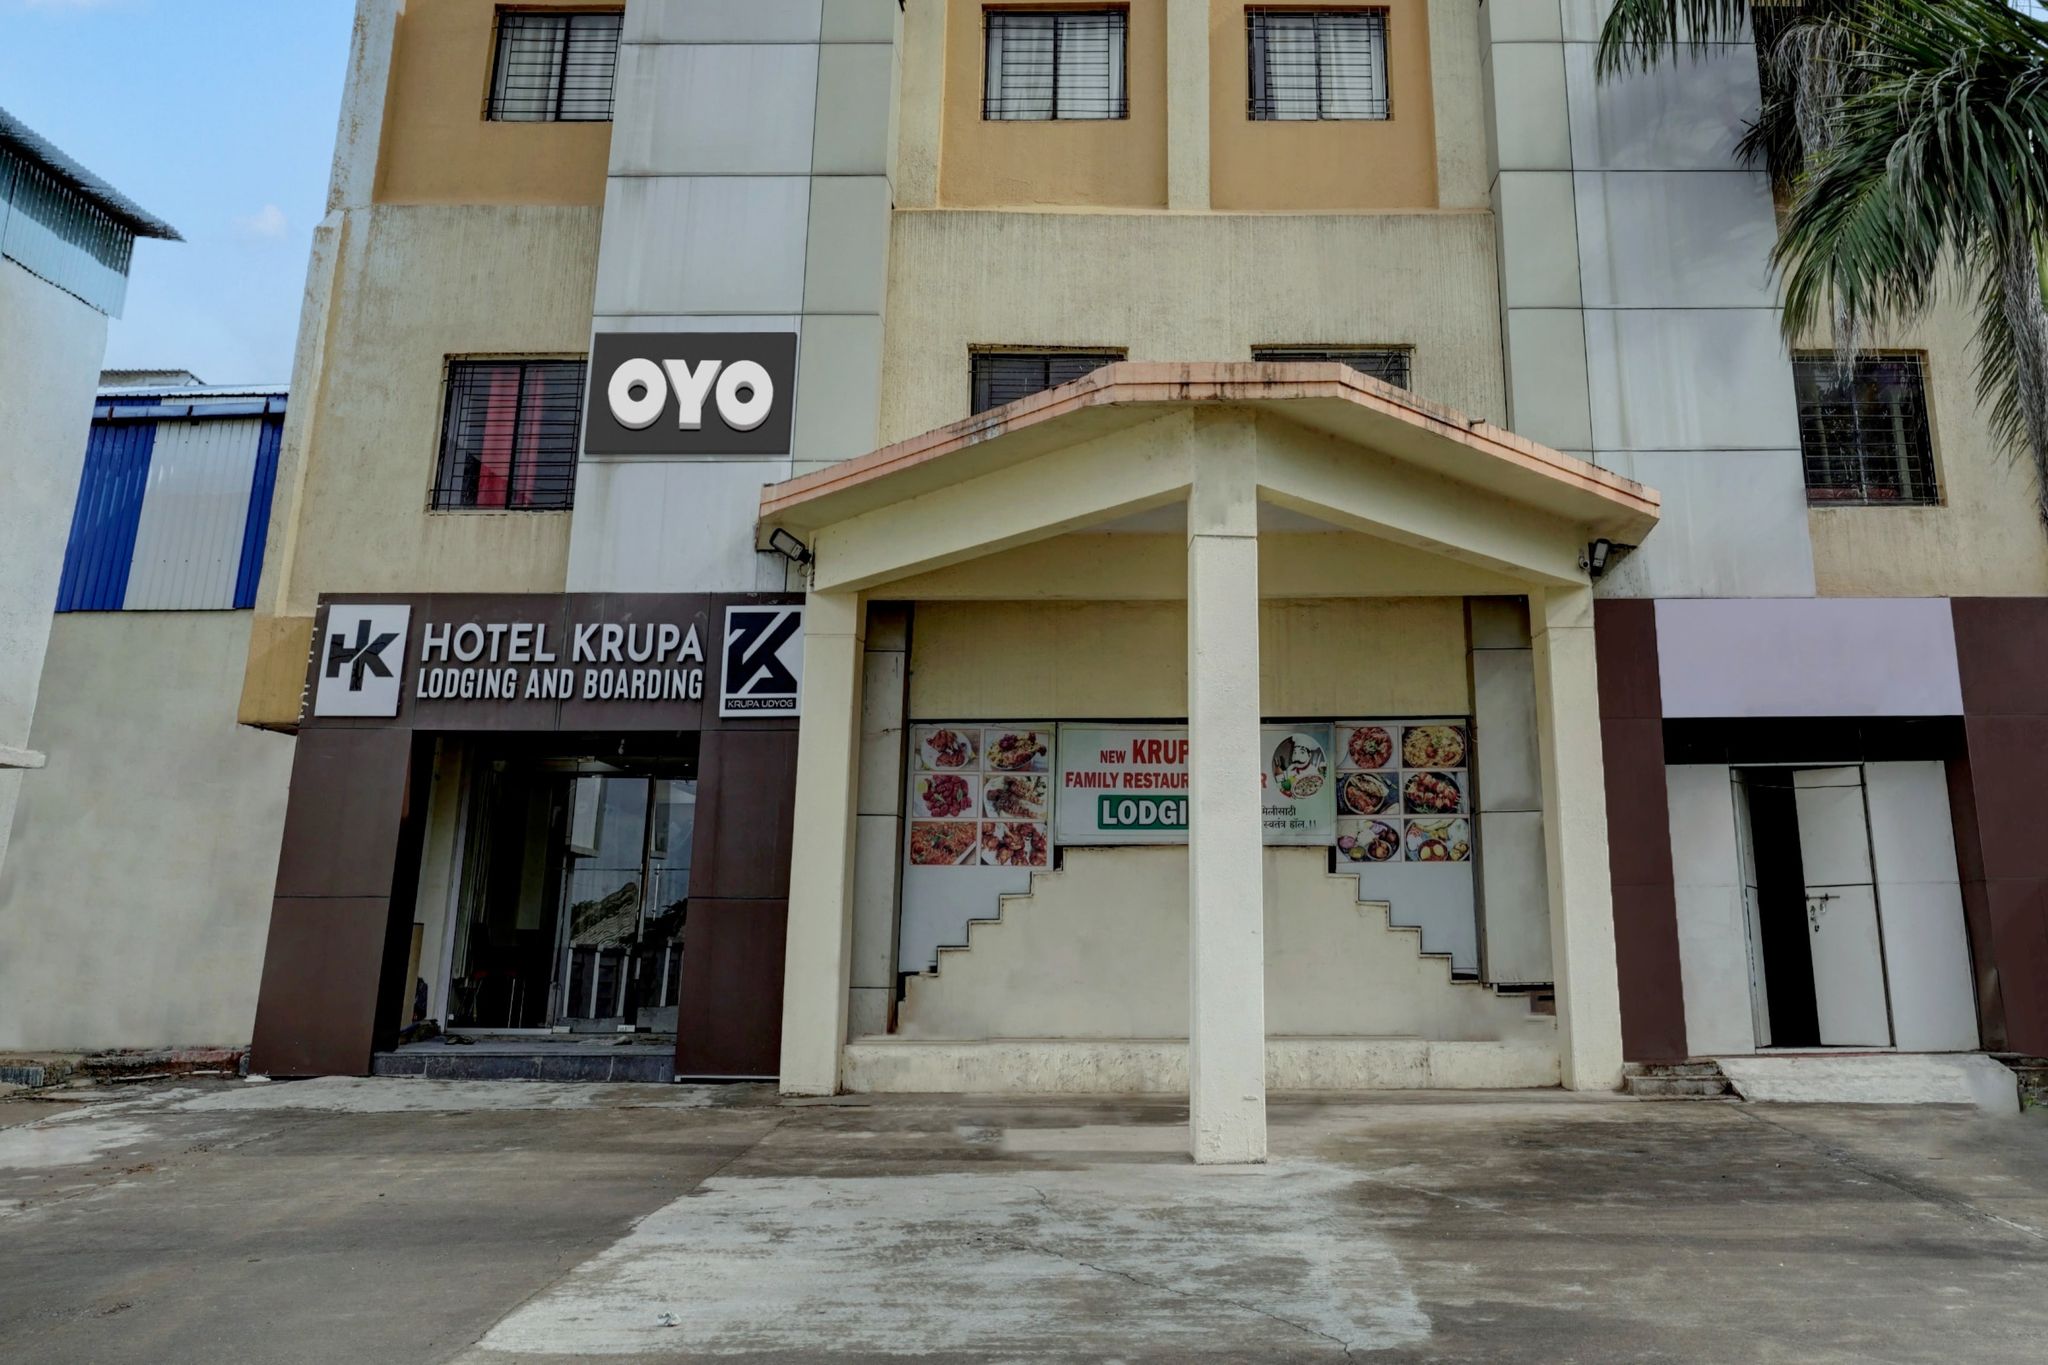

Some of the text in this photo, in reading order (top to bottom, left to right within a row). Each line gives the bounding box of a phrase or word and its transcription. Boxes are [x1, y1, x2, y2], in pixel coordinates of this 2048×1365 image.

[607, 357, 774, 432] OYO
[421, 622, 704, 662] HOTEL KRUPA
[416, 667, 703, 700] LODGING AND BOARDING
[727, 699, 794, 708] KRUPA UDYOG
[1100, 739, 1189, 764] NEW KRUP
[1065, 771, 1189, 789] FAMILY RESTAUR
[1102, 799, 1188, 825] LODGI
